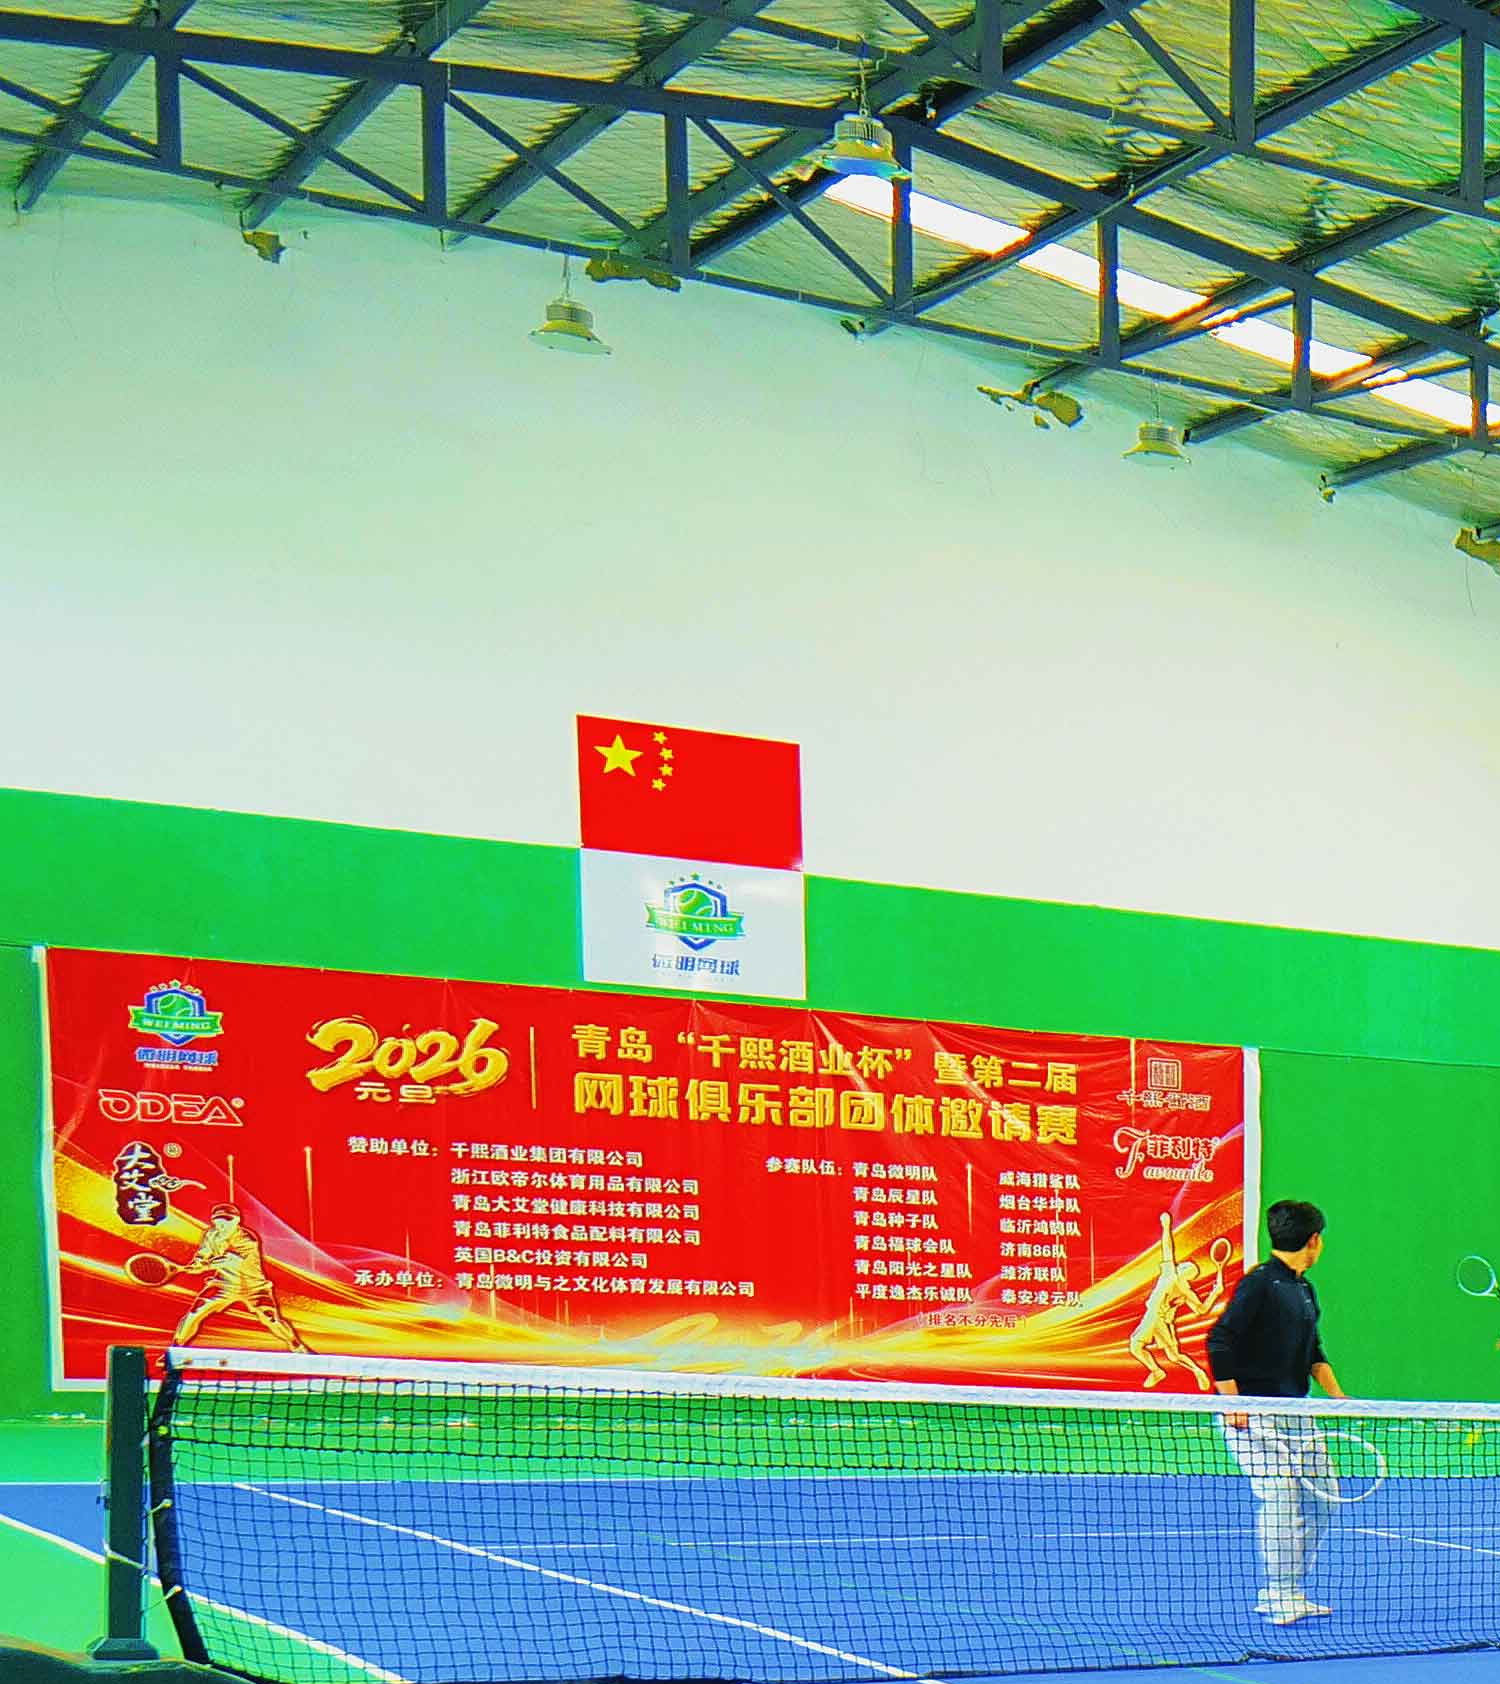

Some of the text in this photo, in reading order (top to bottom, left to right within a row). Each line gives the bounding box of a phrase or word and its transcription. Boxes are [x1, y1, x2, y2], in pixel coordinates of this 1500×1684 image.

[305, 1015, 511, 1097] 2026
[353, 1081, 437, 1104] 元旦
[573, 1071, 1079, 1146] 网球俱乐部团体邀请赛
[450, 1142, 643, 1168] 千熙酒业集团有限公司
[451, 1168, 699, 1196] 浙江欧帝尔体育用品有限公司
[451, 1194, 700, 1221] 青岛大艾堂健康科技有限公司
[853, 1186, 939, 1205] 青岛辰星队
[853, 1210, 939, 1230] 青岛种子队
[453, 1220, 701, 1246] 青岛菲利特食品配料有限公司
[455, 1247, 648, 1269] 英国B&C投资有限公司
[1000, 1242, 1068, 1259] 济南86队
[855, 1259, 973, 1279] 青岛阳光之星队
